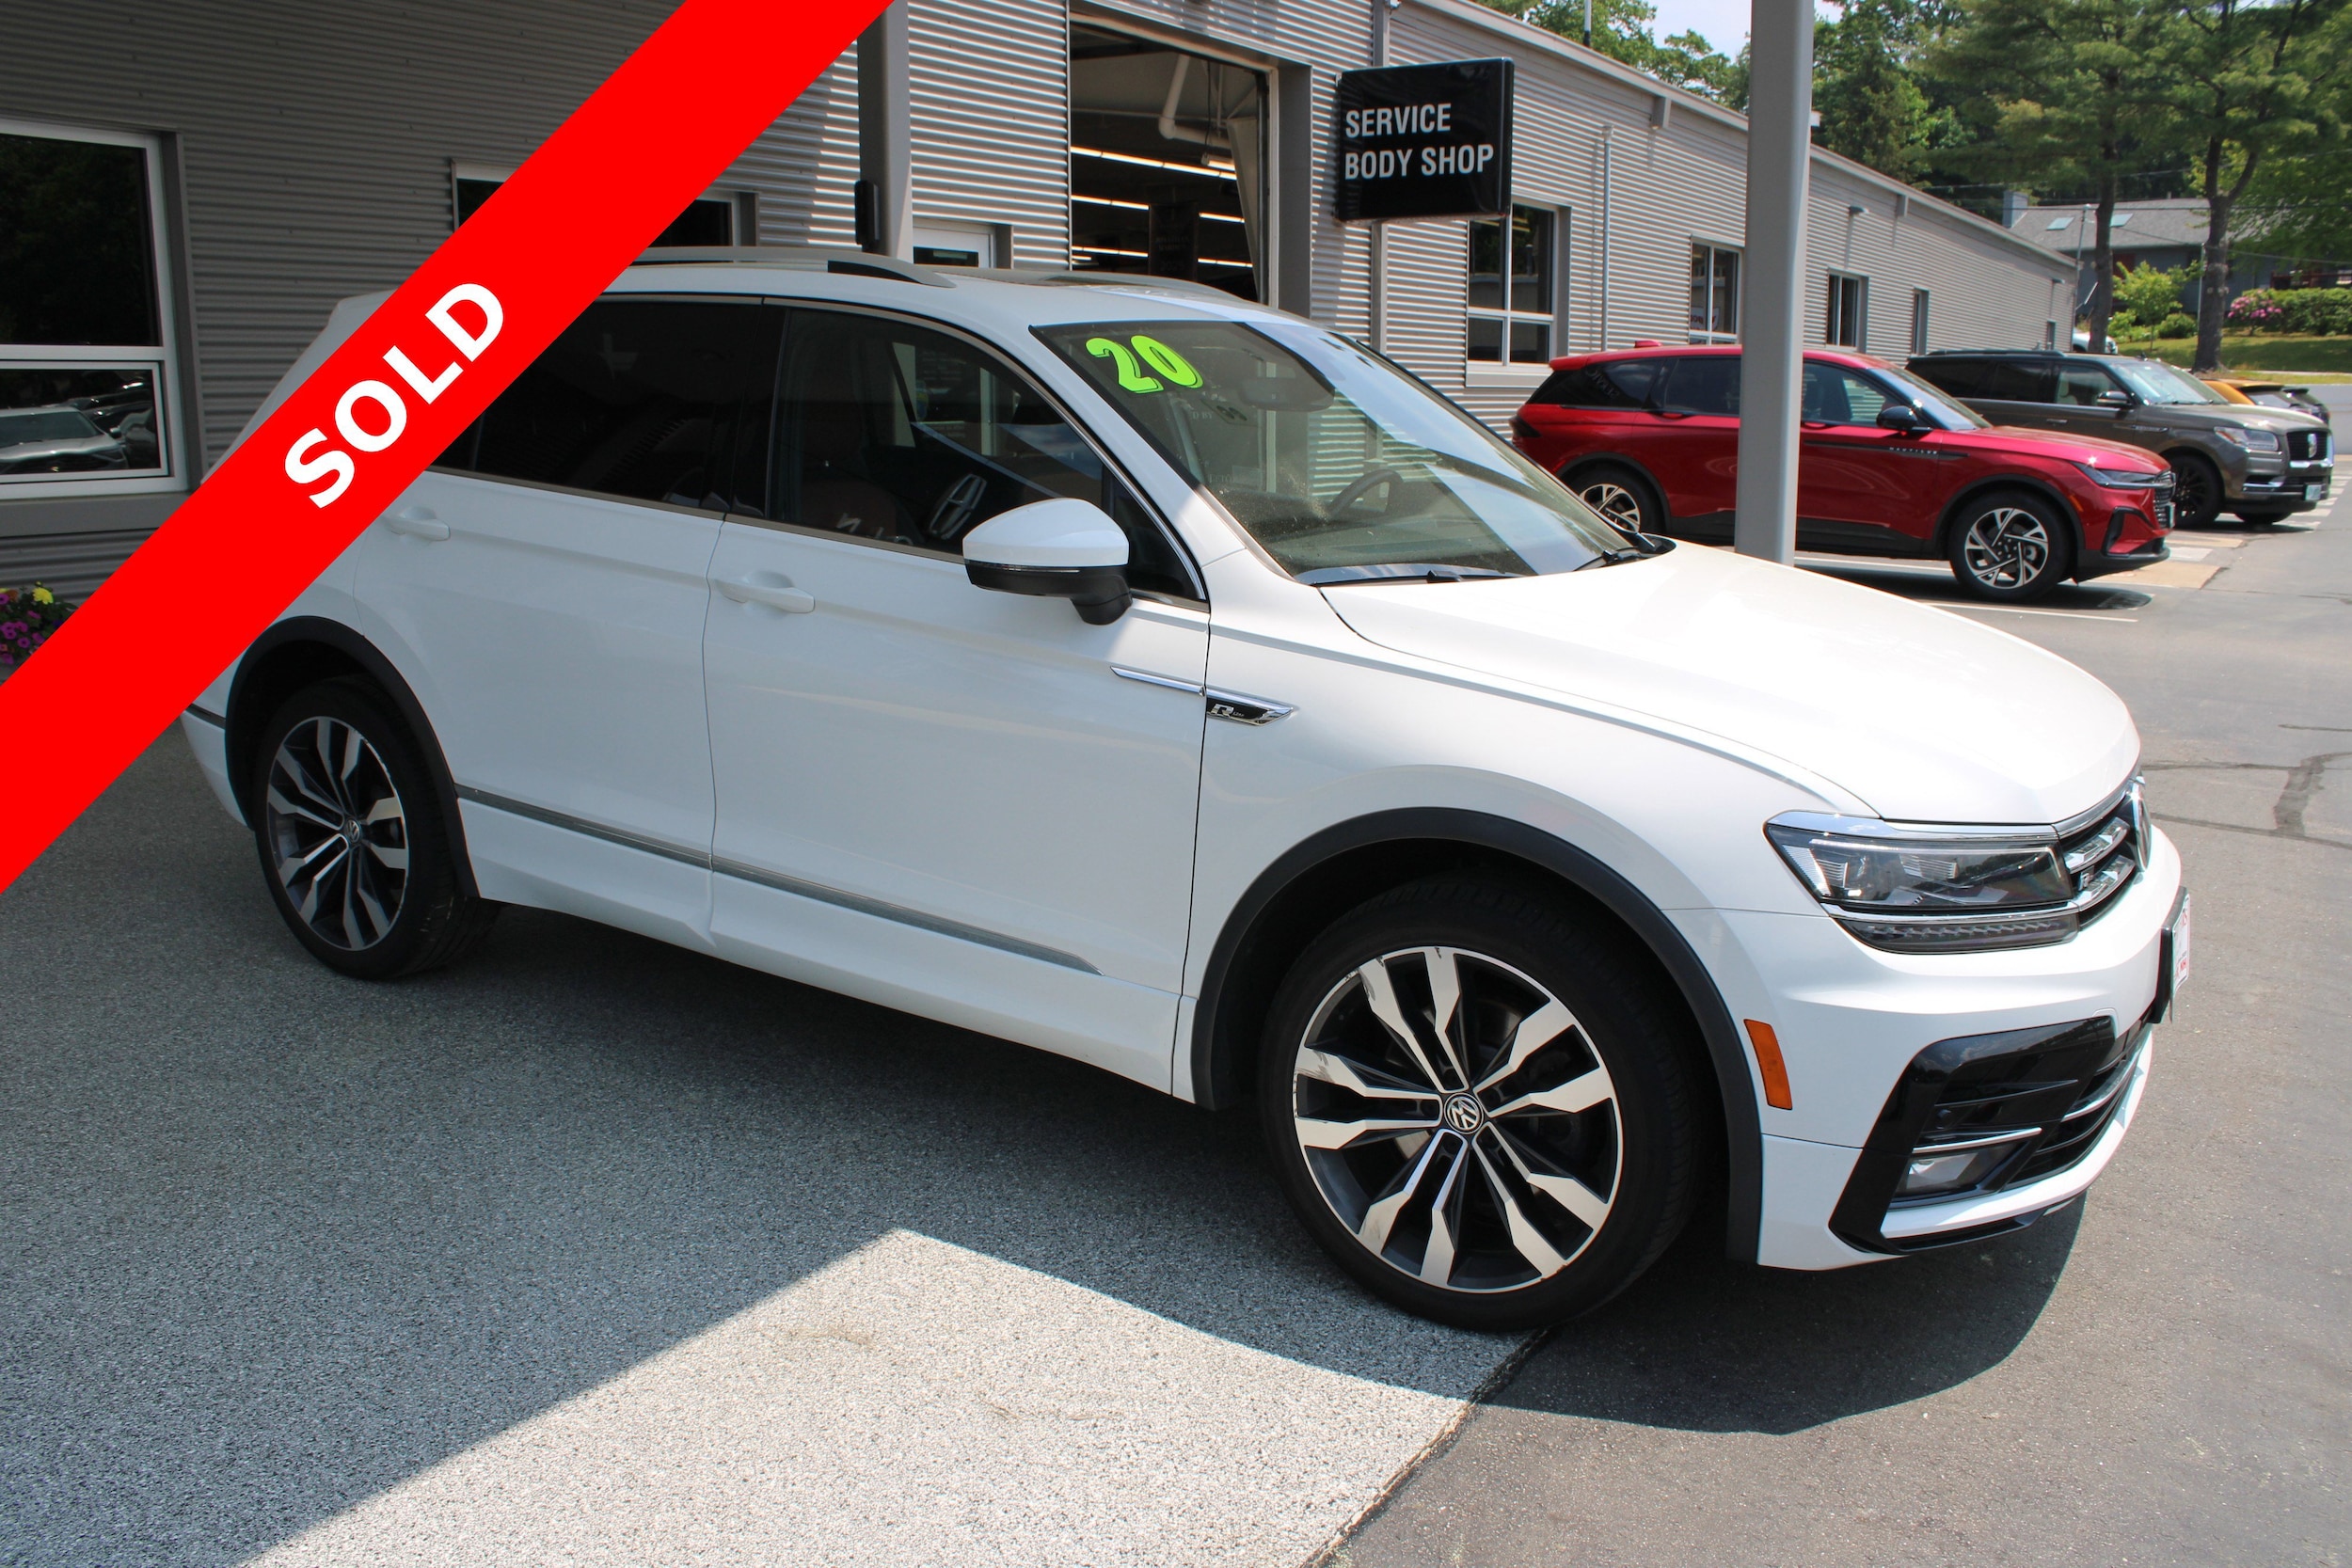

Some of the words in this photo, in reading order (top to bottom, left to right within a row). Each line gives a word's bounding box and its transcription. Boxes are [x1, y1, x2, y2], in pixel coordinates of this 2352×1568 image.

[1345, 103, 1452, 138] SERVICE
[1344, 149, 1413, 180] BODY
[1421, 144, 1494, 176] SHOP
[1085, 335, 1204, 394] 20
